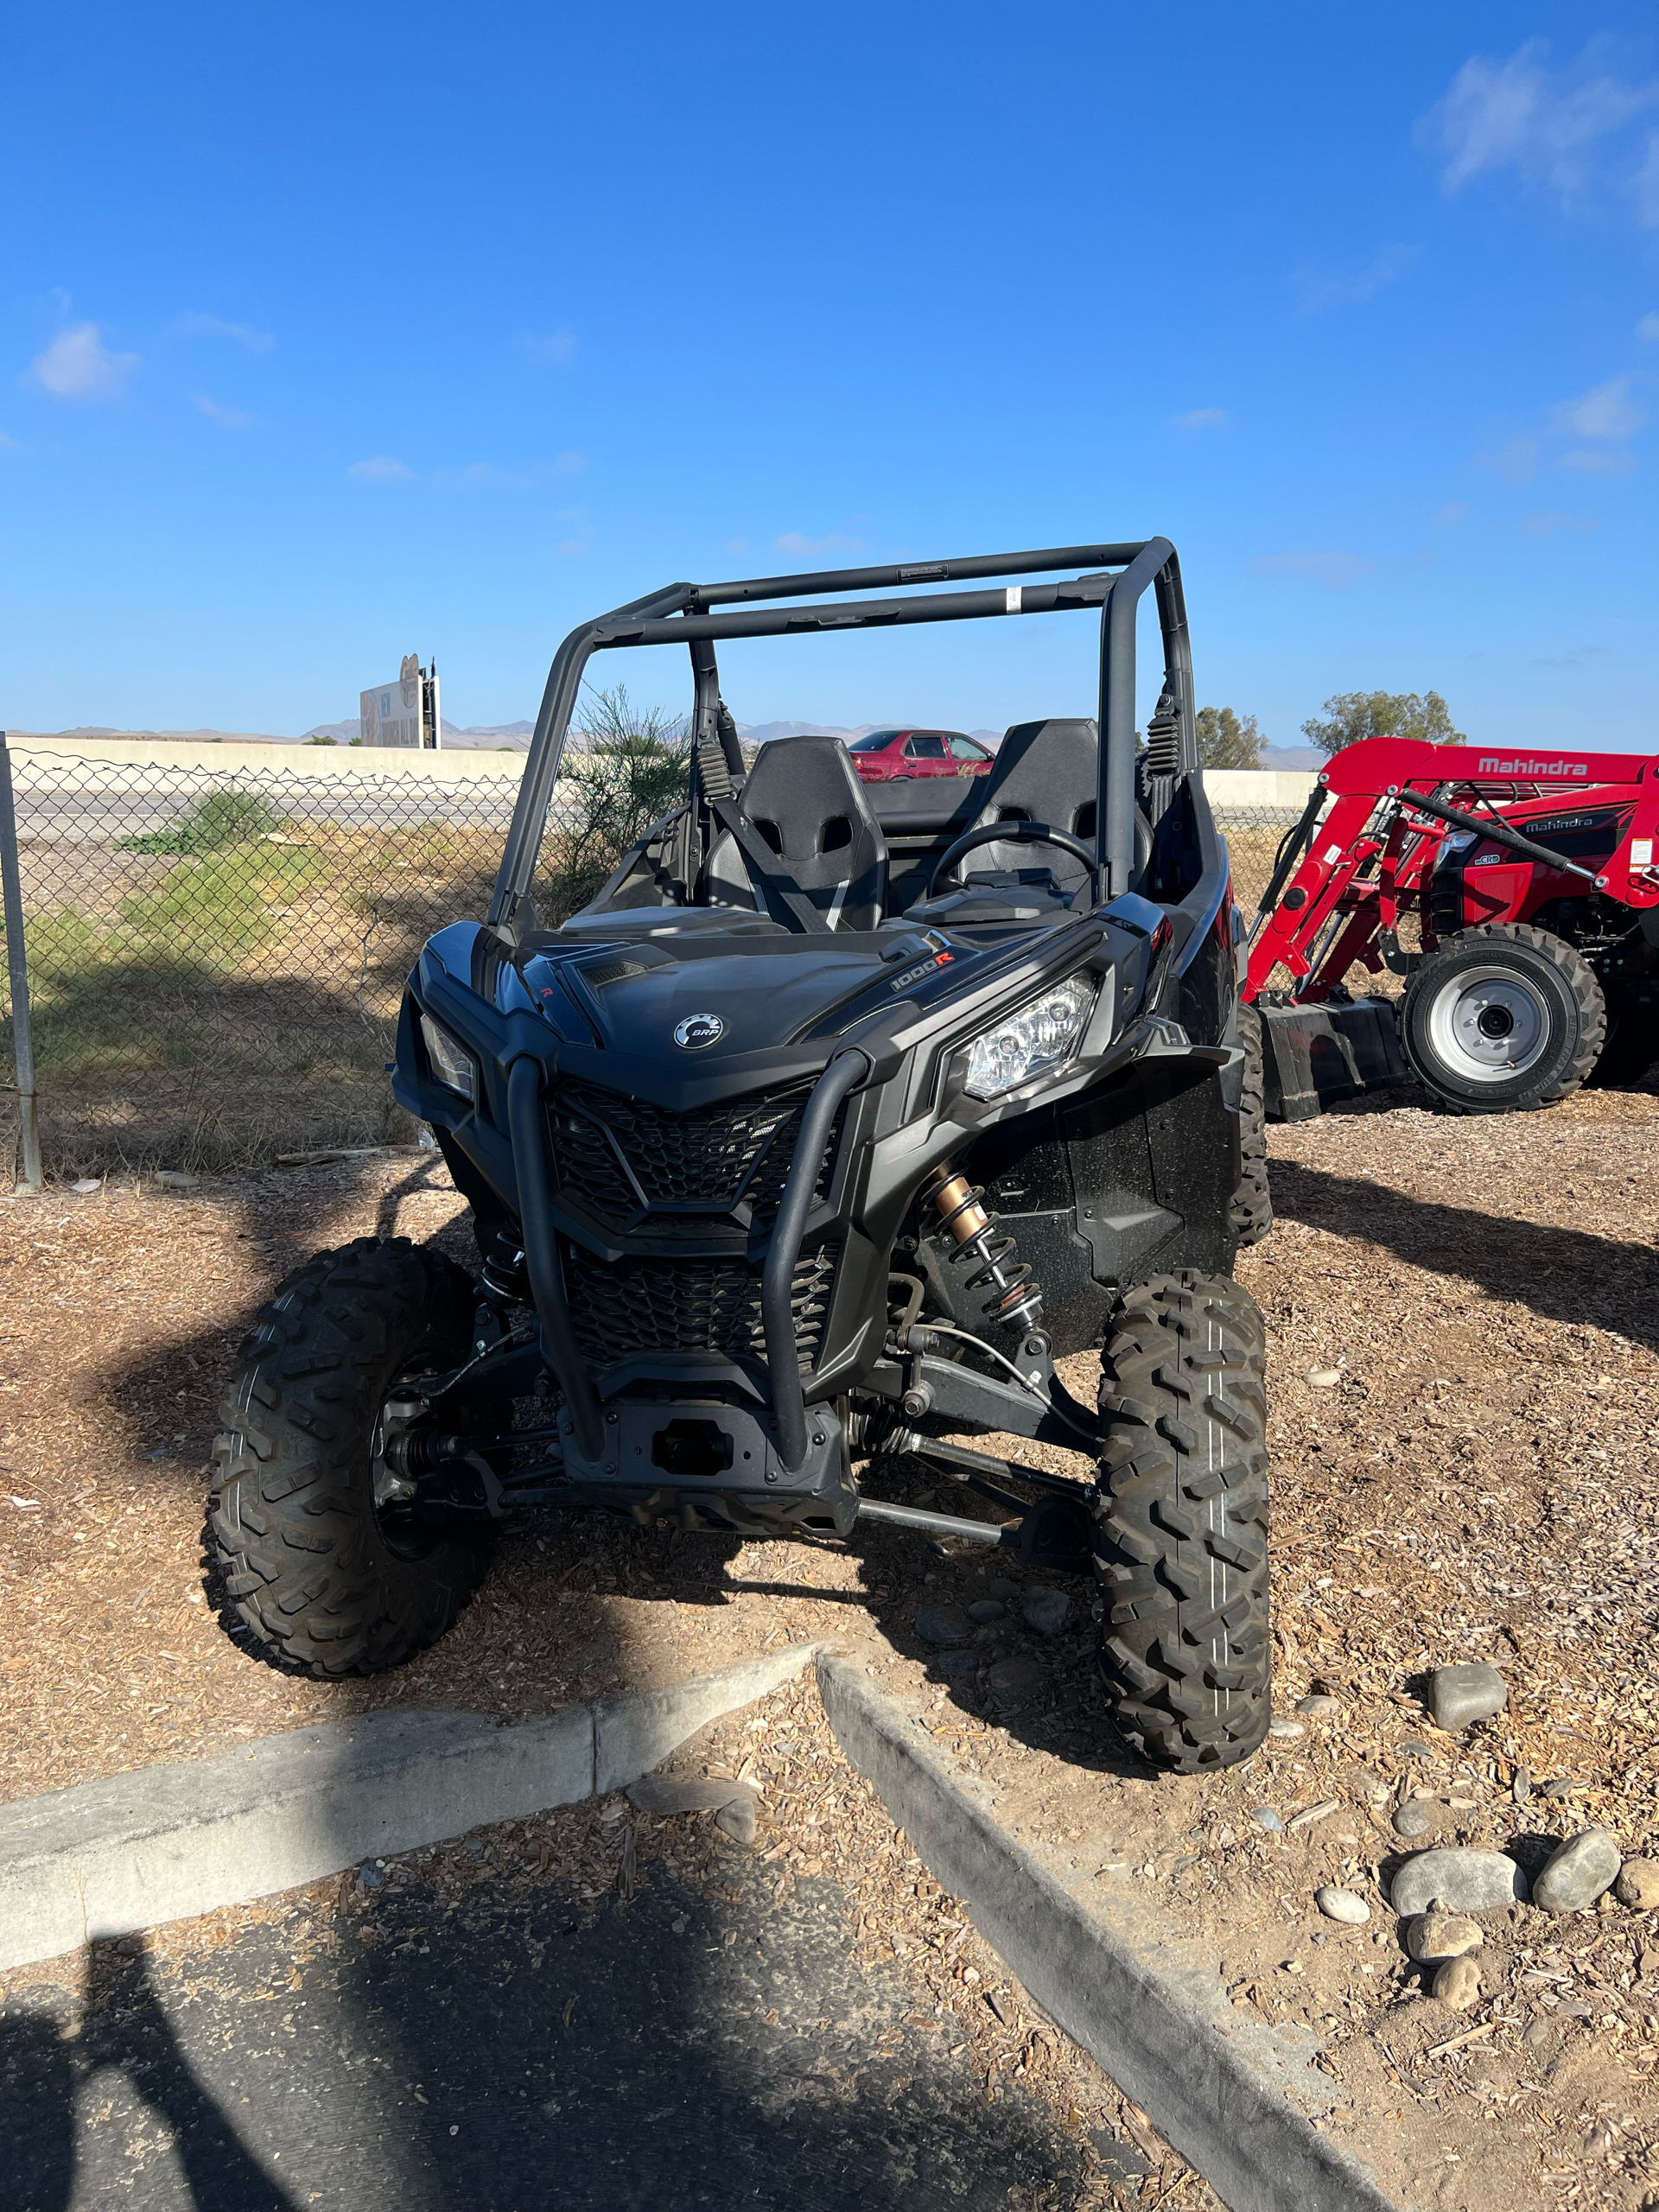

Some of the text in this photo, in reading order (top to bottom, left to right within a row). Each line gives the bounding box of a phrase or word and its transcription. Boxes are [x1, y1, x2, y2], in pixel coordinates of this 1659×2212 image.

[1478, 758, 1587, 775] Mahindra
[1526, 817, 1592, 833] Mahindra
[540, 987, 554, 998] R
[1521, 1015, 1577, 1100] JET TRAX SUPER
